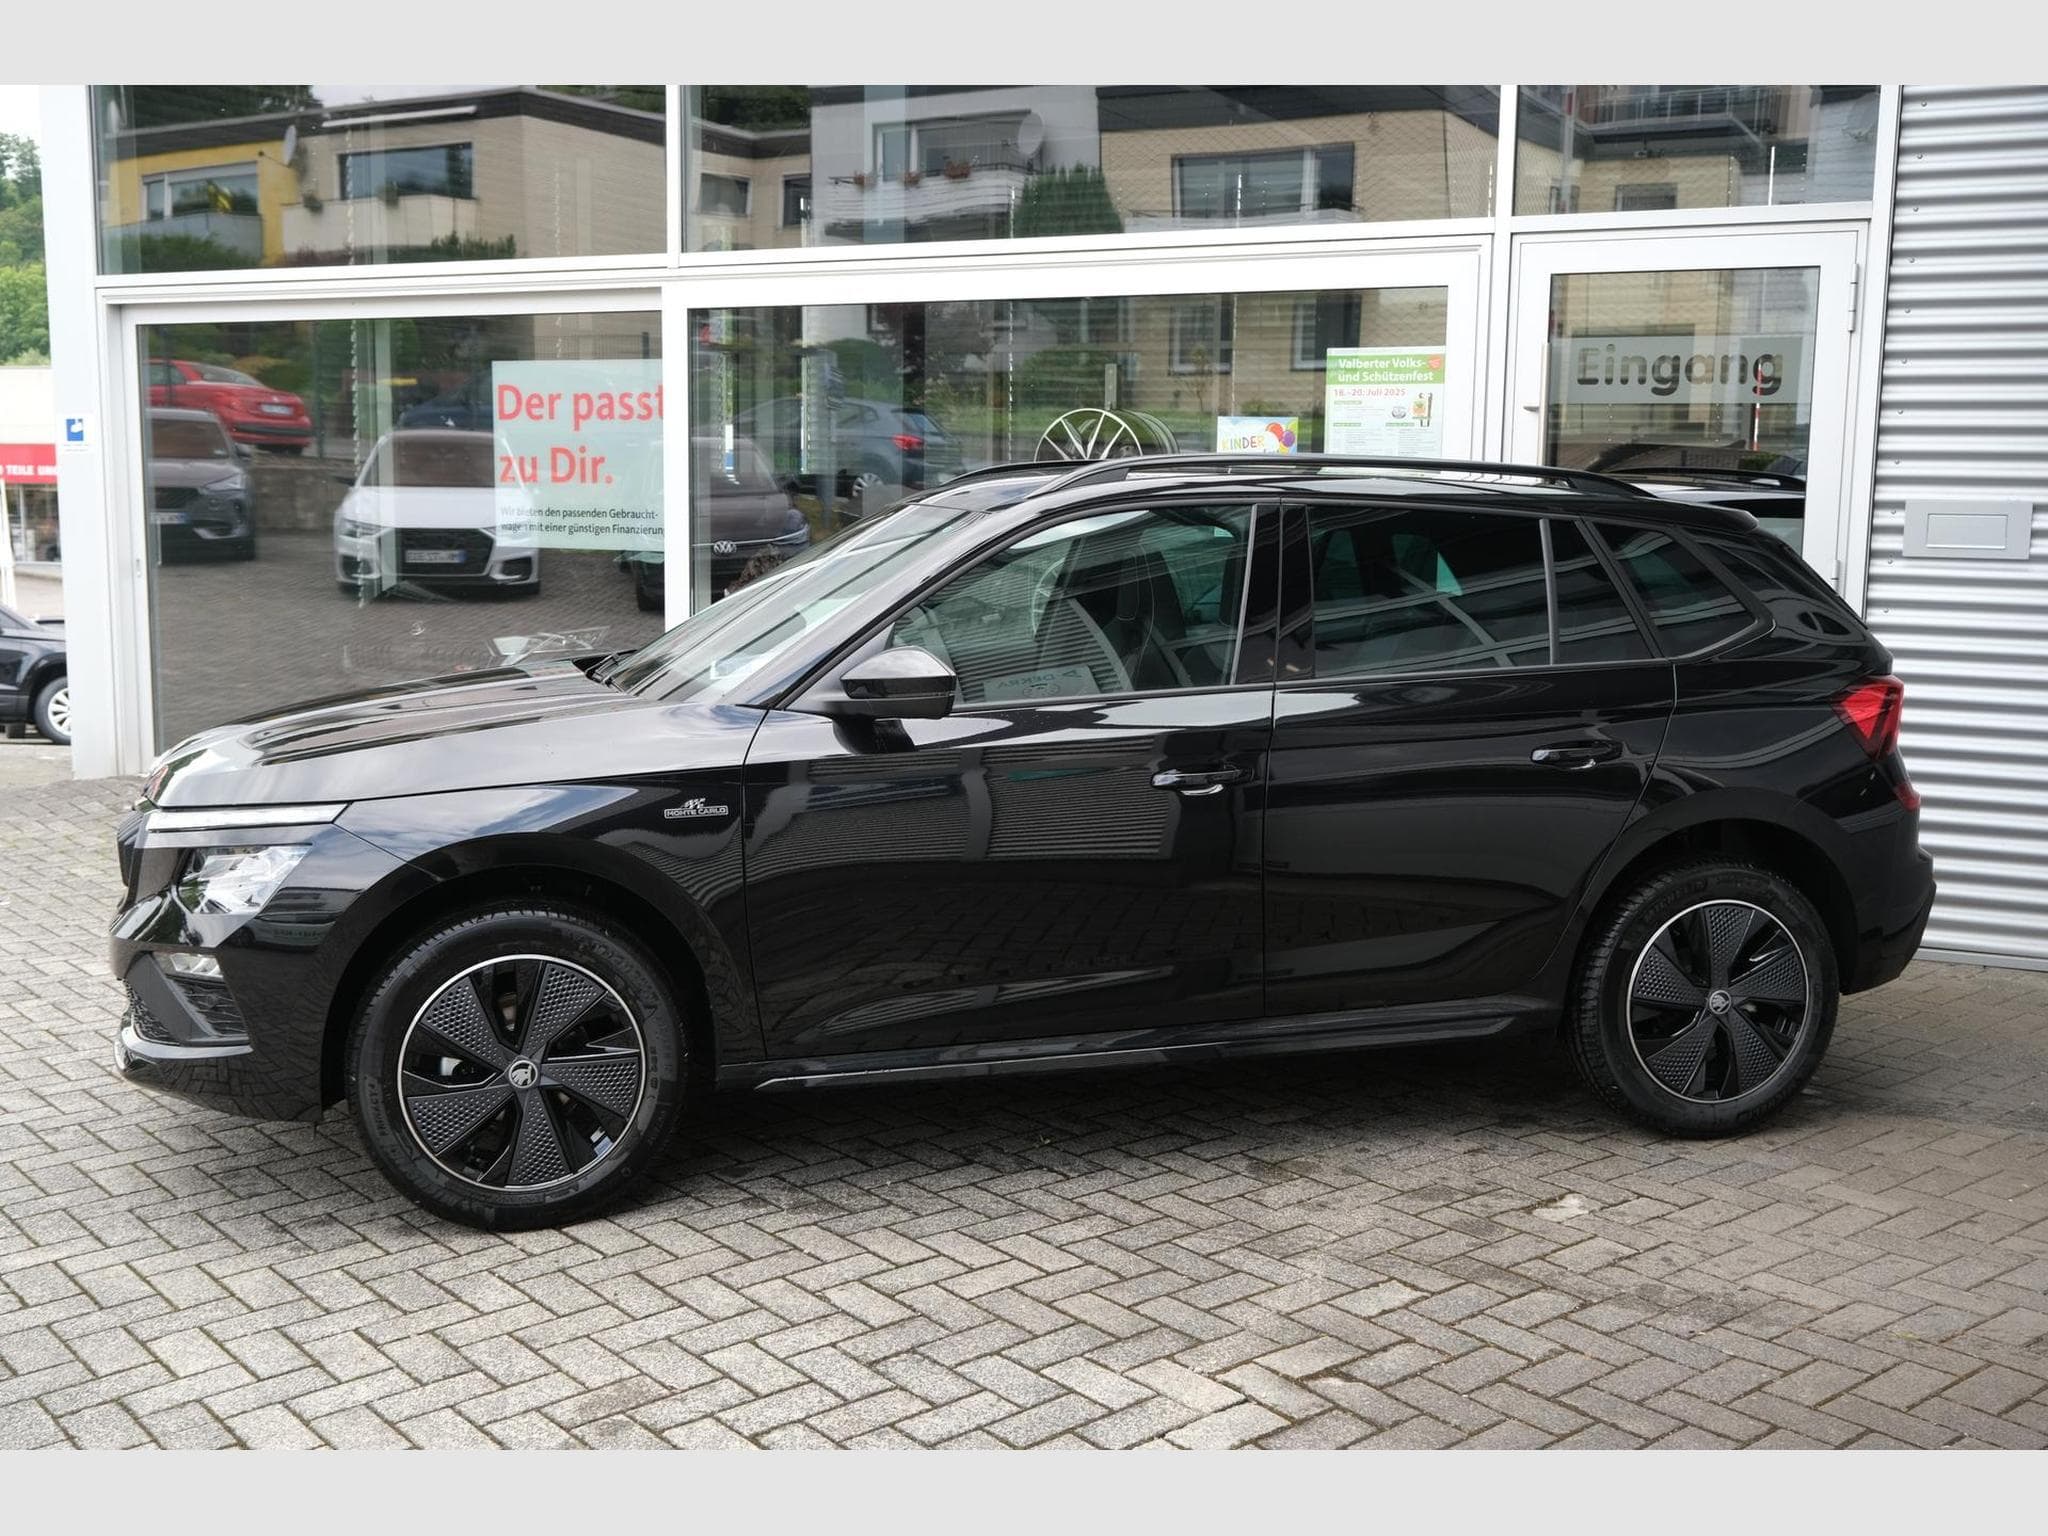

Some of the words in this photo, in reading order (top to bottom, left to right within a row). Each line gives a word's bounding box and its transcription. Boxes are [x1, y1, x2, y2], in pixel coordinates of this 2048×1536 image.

[1338, 358, 1390, 369] Valberter
[1391, 357, 1427, 368] Volks-
[1577, 343, 1784, 396] Eingang
[1338, 371, 1360, 382] und
[1362, 370, 1434, 382] Schützenfest
[498, 384, 562, 421] Der
[573, 384, 663, 431] passt
[1221, 435, 1265, 449] KINDER
[500, 455, 538, 483] zu
[551, 445, 613, 484] Dir.
[545, 507, 560, 517] den
[562, 507, 607, 519] passenden
[609, 508, 658, 519] Gebraucht-
[545, 523, 566, 532] einer
[568, 522, 610, 535] günstigen
[612, 523, 664, 535] Finanzierun
[667, 809, 697, 817] MONTE
[698, 807, 726, 815] CARLO
